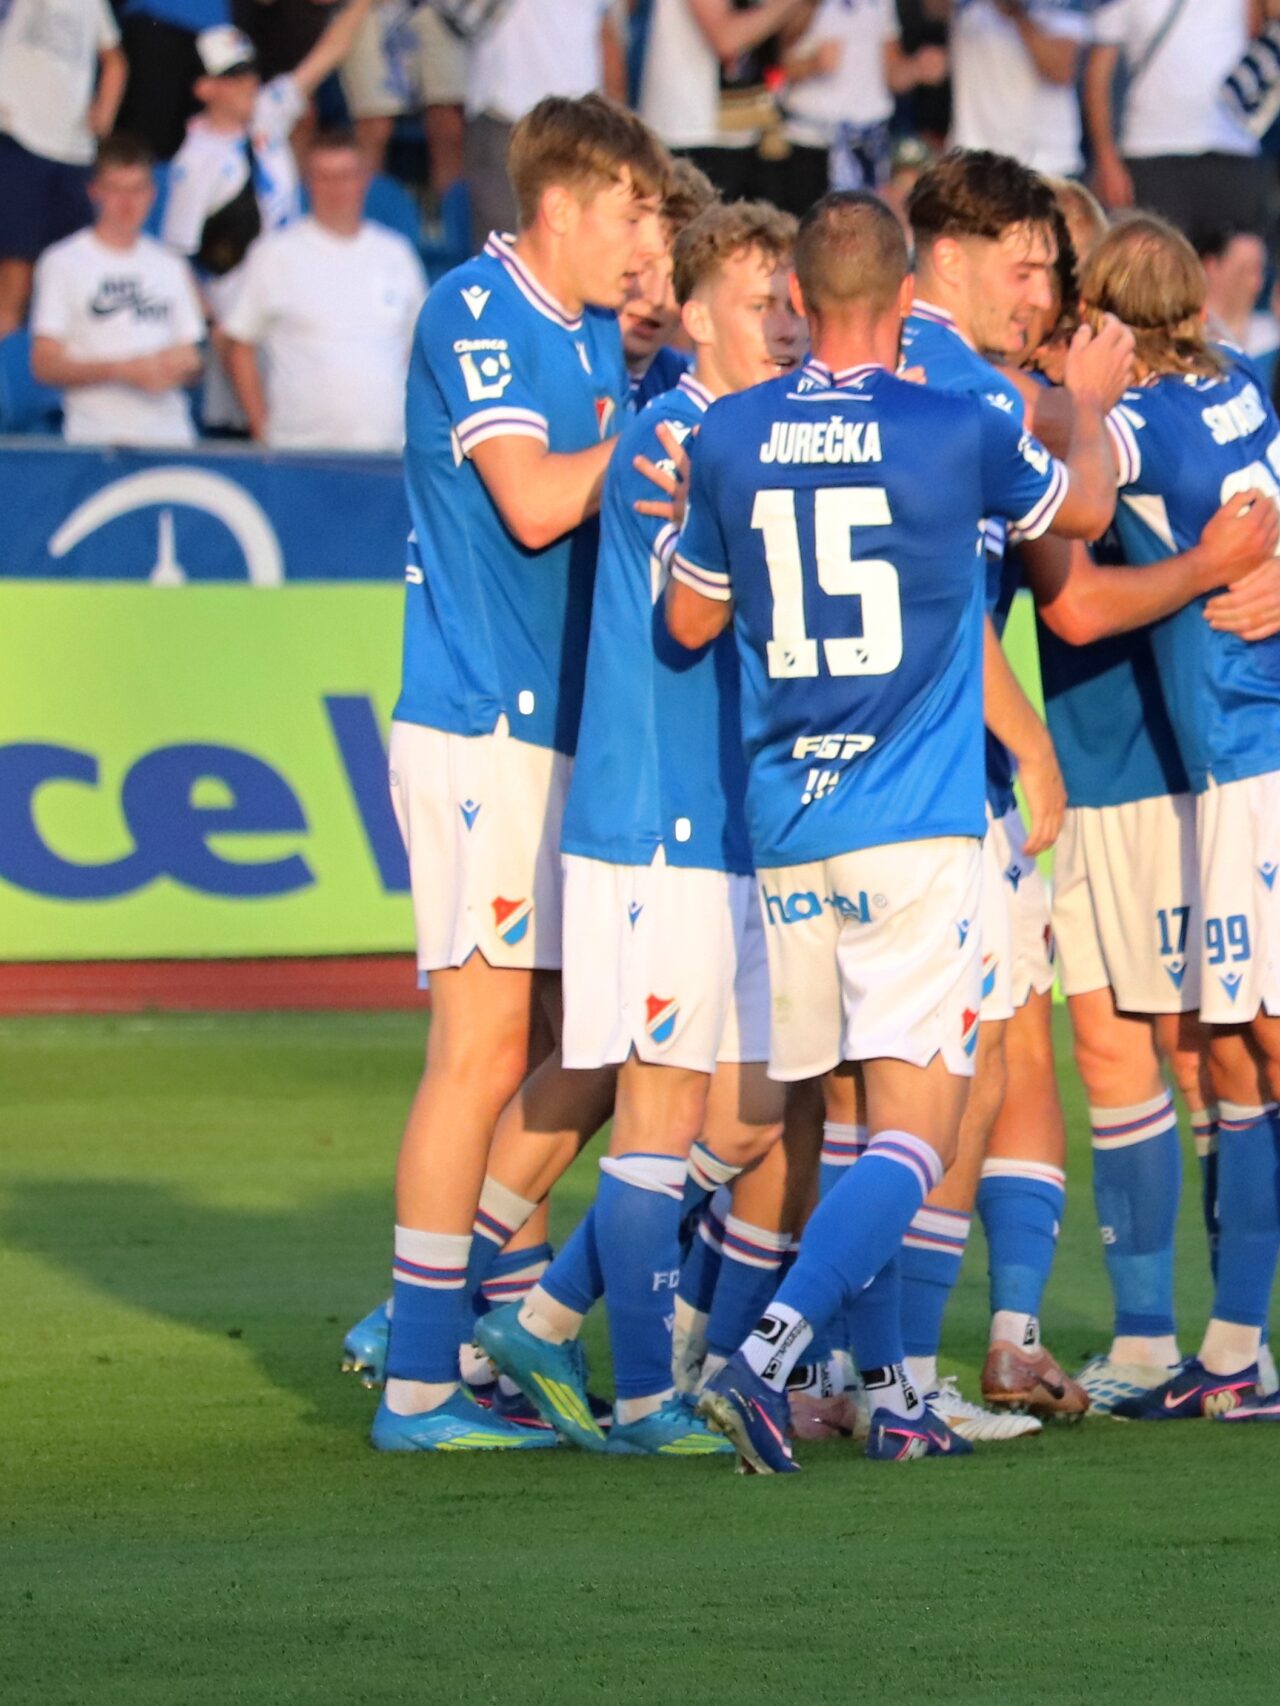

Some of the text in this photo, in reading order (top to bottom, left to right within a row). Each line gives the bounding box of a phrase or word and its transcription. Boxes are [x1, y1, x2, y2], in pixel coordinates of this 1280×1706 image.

[453, 339, 509, 353] Chance
[760, 415, 882, 464] JUREČKA
[750, 487, 903, 678] 15
[1157, 906, 1190, 956] 17
[1205, 914, 1251, 965] 99
